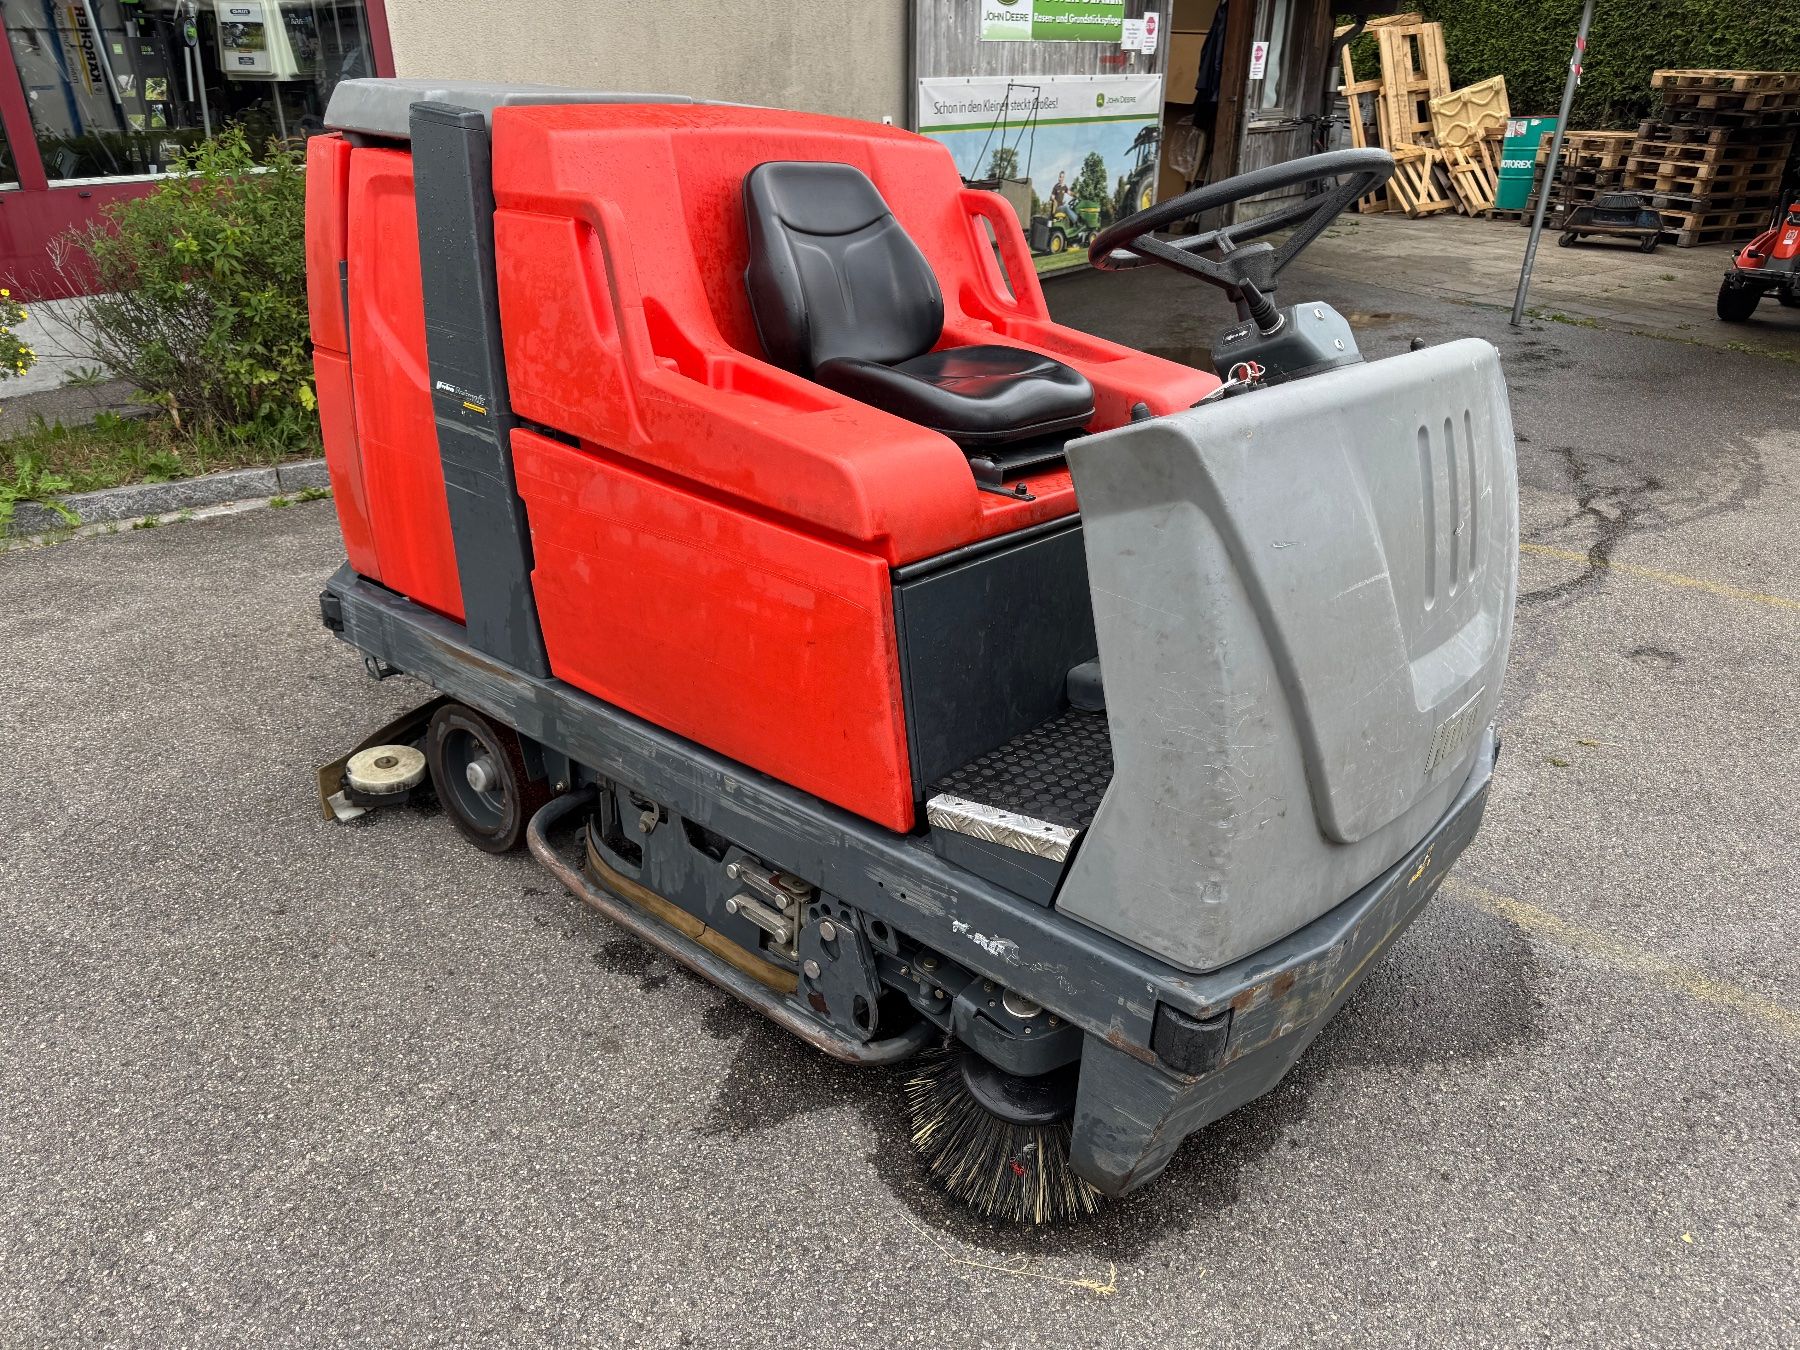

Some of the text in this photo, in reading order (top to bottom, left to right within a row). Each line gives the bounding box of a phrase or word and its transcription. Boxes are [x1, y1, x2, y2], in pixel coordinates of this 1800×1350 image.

[984, 10, 1029, 22] JOHN DEERE
[1055, 13, 1068, 23] und
[933, 100, 958, 115] Schon
[959, 100, 967, 113] in
[967, 99, 982, 113] den
[1010, 98, 1031, 111] steckt
